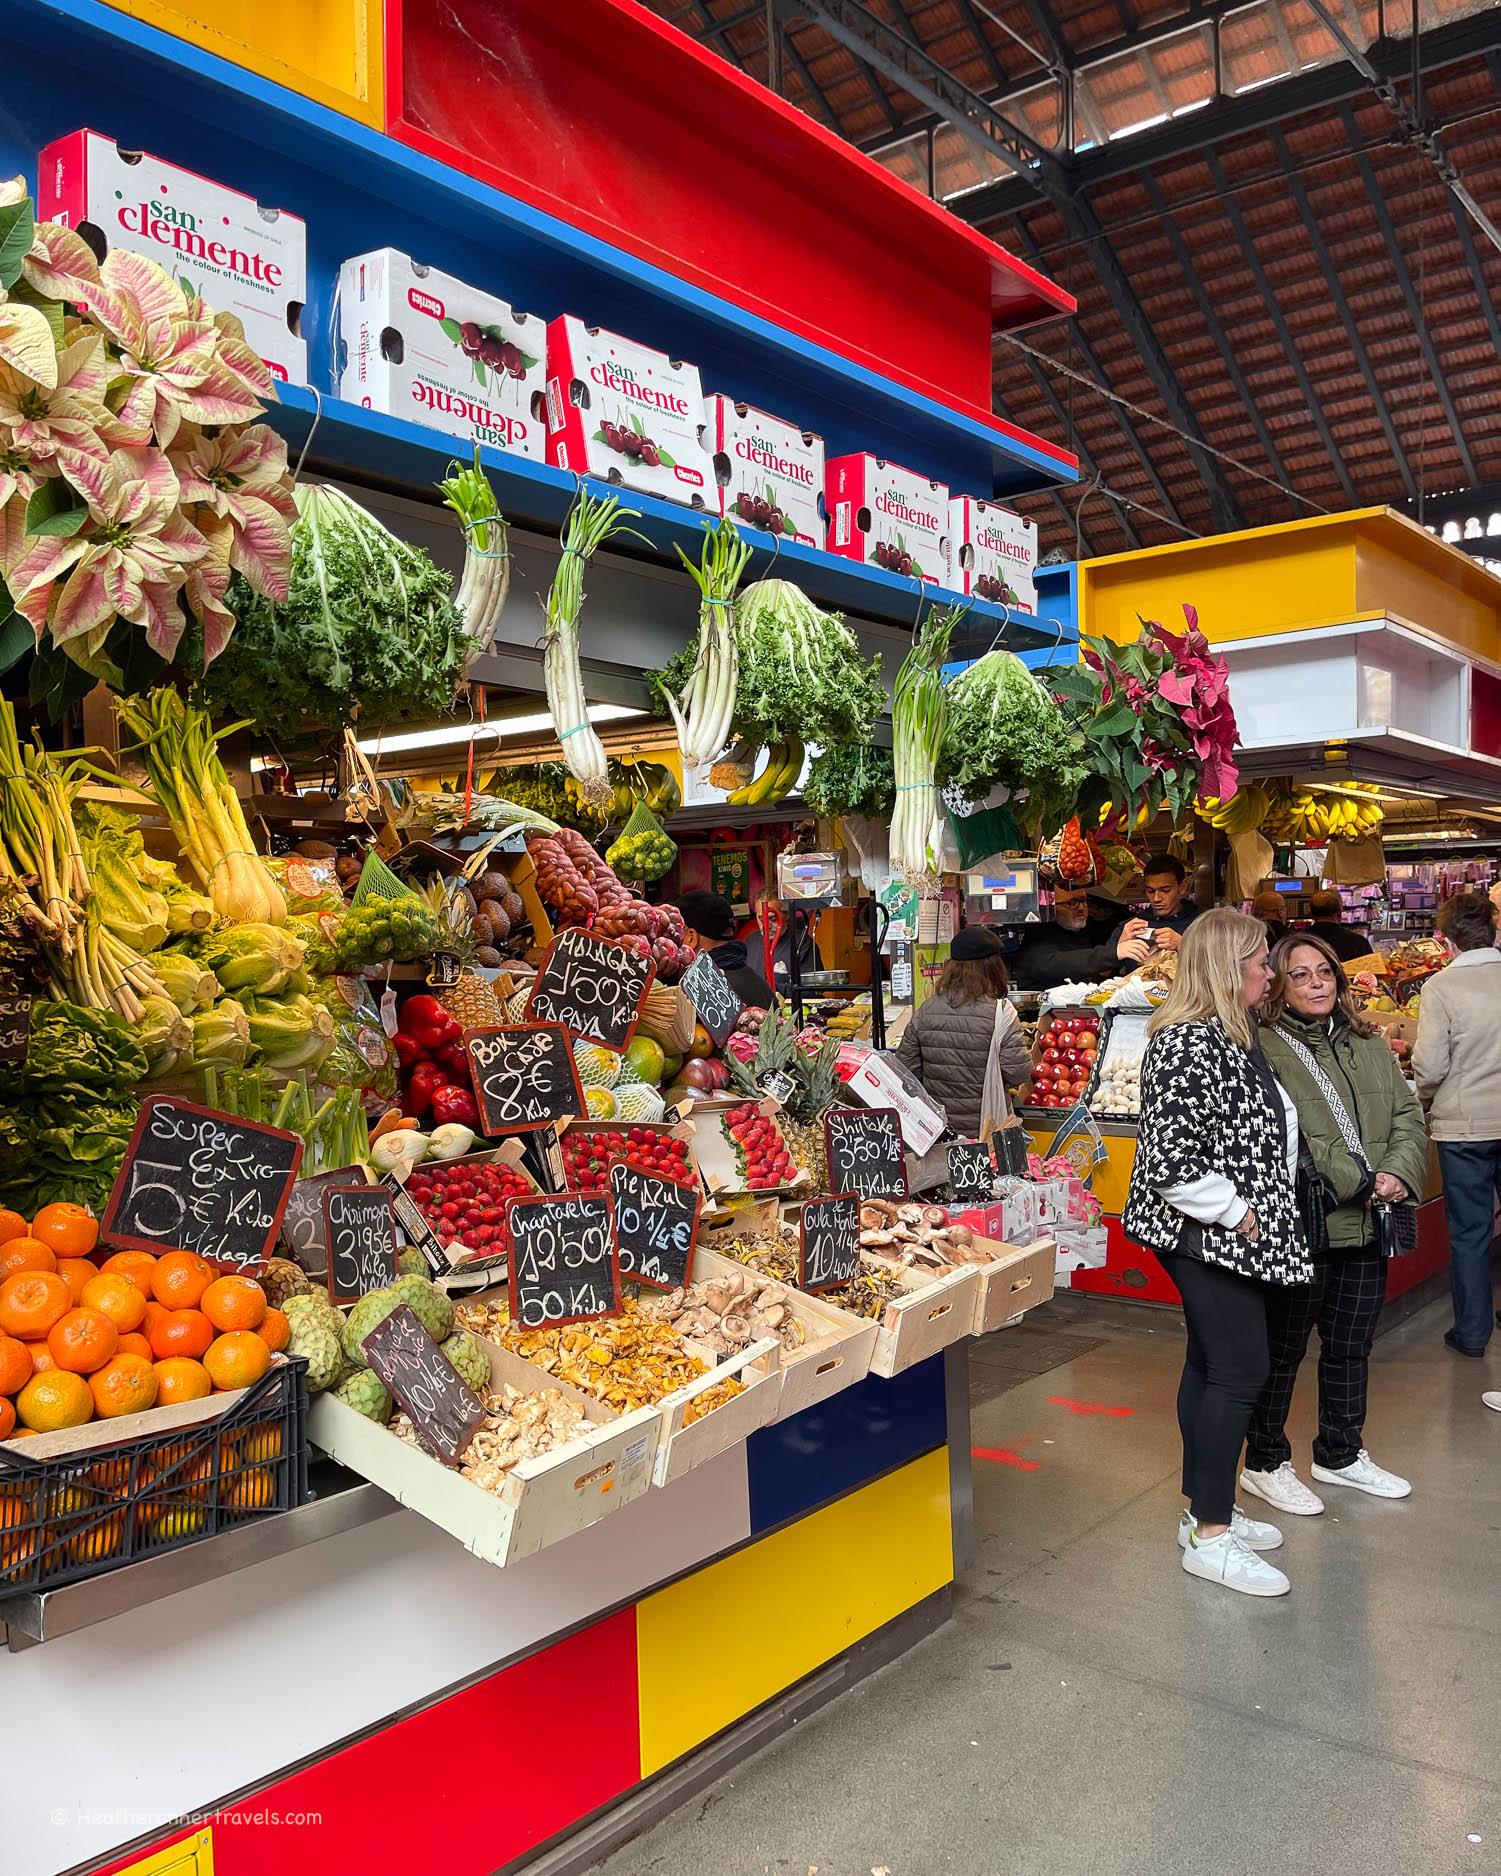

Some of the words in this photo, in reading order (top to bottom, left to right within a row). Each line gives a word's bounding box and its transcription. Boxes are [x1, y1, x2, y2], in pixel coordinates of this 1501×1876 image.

[150, 200, 198, 233] san
[117, 203, 282, 287] clemente
[176, 251, 191, 264] the
[193, 258, 220, 275] colour
[223, 269, 231, 280] of
[233, 273, 275, 295] freshness
[607, 360, 634, 382] san
[590, 363, 689, 416] clemente
[411, 381, 527, 445] clemente
[474, 424, 506, 448] san
[751, 435, 774, 454] san
[735, 438, 814, 485] clemente
[875, 492, 939, 531] clemente
[887, 489, 906, 505] san
[977, 529, 1031, 562] clemente
[987, 526, 1003, 540] san
[712, 852, 749, 866] TENEMOS
[531, 994, 606, 1040] PAPAYA
[151, 1103, 244, 1153] Super
[948, 1146, 972, 1170] Chile
[953, 1163, 978, 1188] 20
[610, 1163, 638, 1194] Pie
[225, 1189, 274, 1228] Kilo
[614, 1196, 640, 1234] 10
[832, 1200, 845, 1213] de
[805, 1233, 835, 1285] 10
[520, 1286, 564, 1327] 50
[569, 1283, 607, 1316] Kilo
